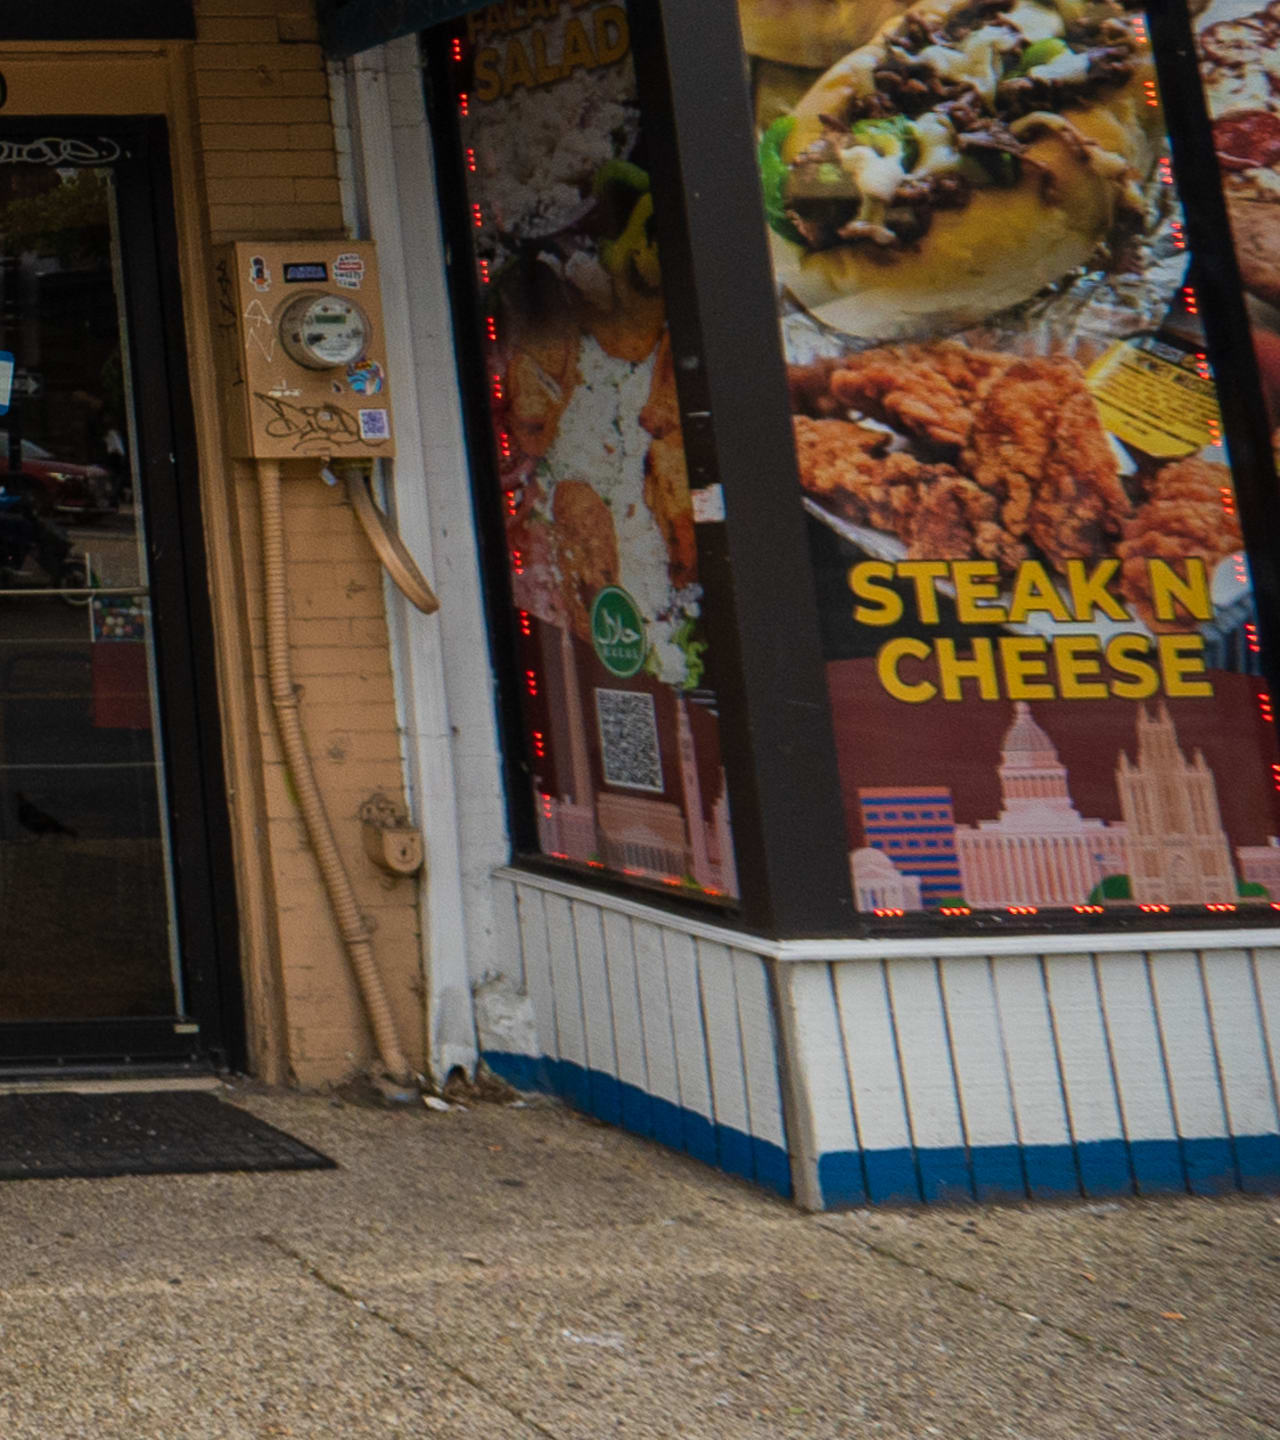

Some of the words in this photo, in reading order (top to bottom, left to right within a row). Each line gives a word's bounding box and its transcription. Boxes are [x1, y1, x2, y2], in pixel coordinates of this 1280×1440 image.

[474, 5, 631, 102] SALAD
[848, 558, 1132, 626] STEAK
[1146, 557, 1215, 622] N
[876, 633, 1215, 704] CHEESE
